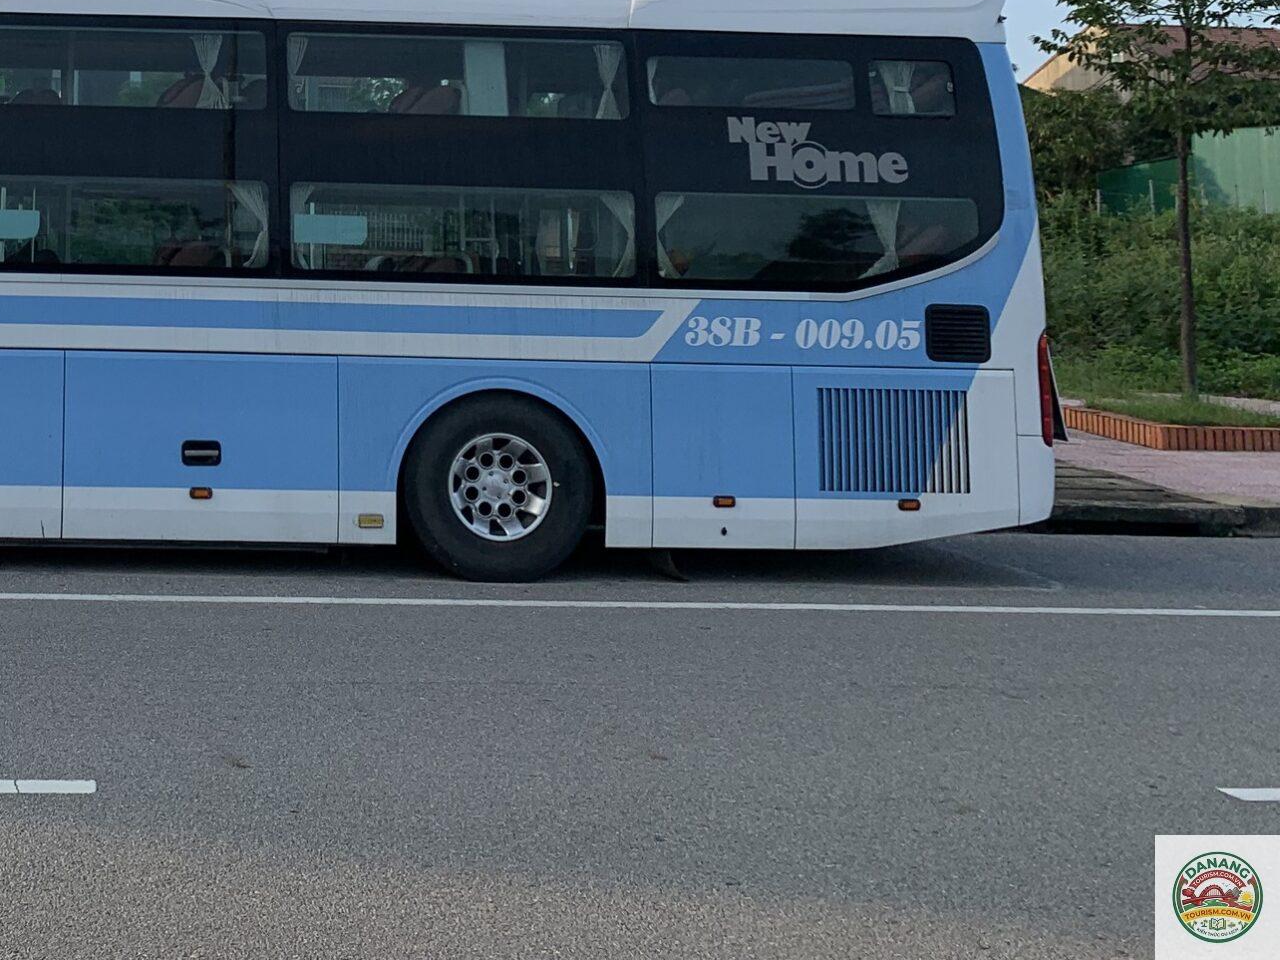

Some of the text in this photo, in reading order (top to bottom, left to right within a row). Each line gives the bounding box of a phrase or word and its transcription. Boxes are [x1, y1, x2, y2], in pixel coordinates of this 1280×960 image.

[727, 116, 812, 144] New
[748, 140, 909, 189] Home
[683, 316, 763, 347] 38B
[794, 318, 923, 351] 009.05
